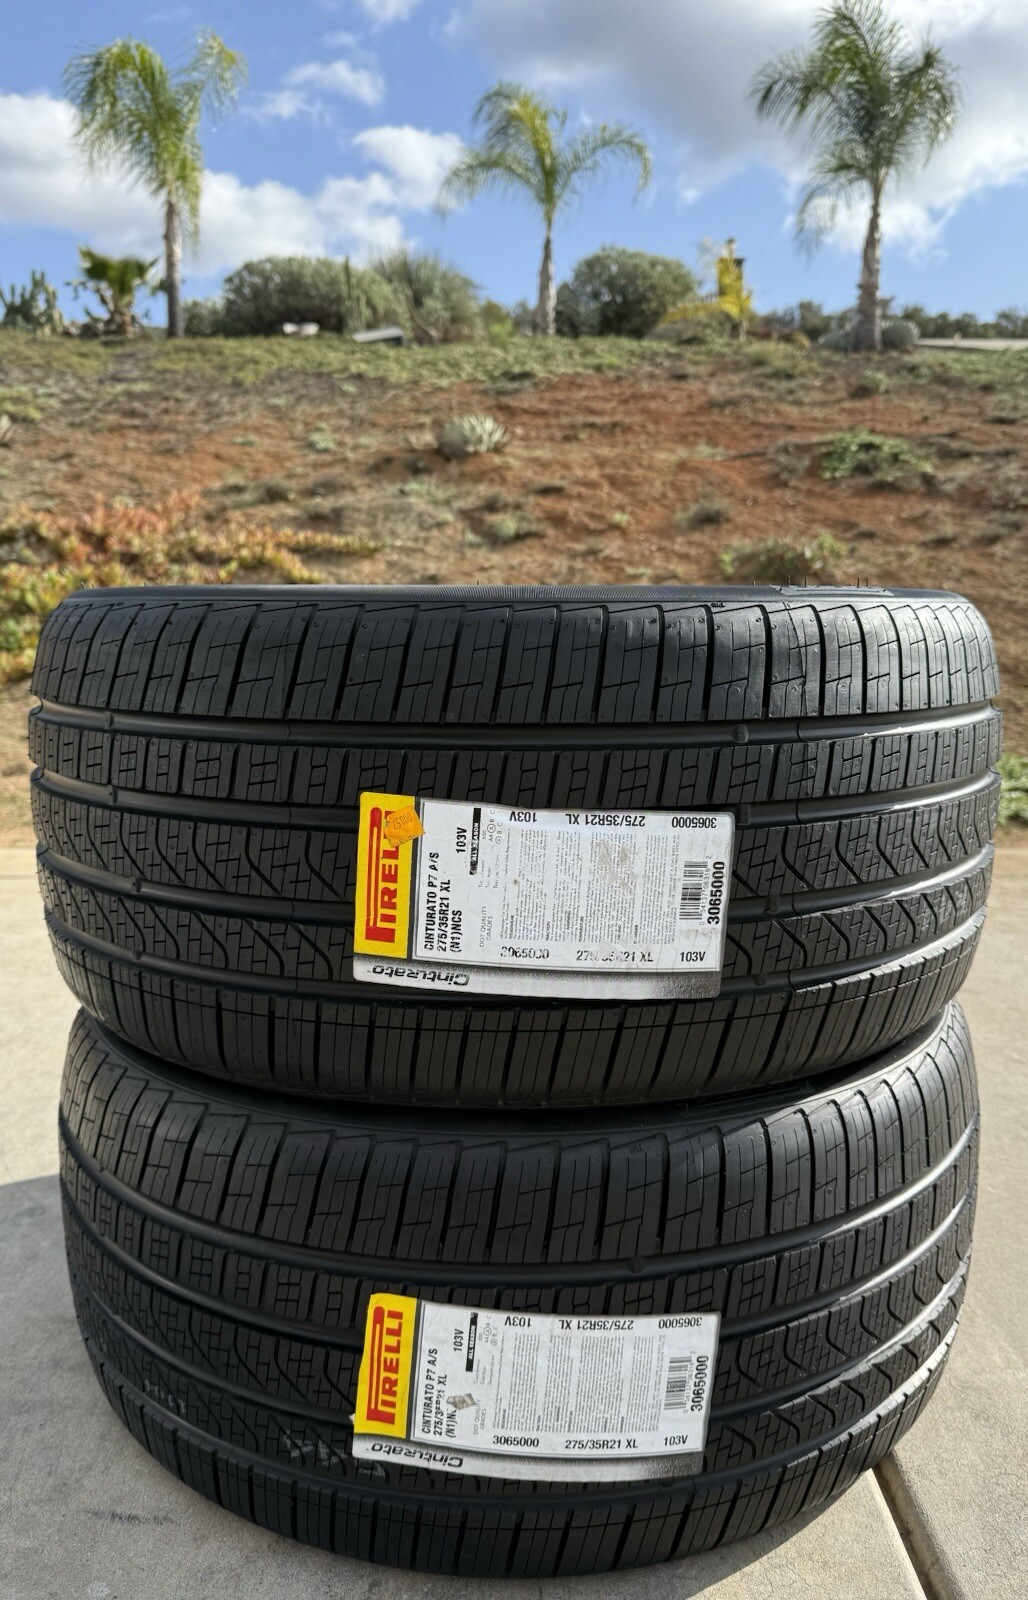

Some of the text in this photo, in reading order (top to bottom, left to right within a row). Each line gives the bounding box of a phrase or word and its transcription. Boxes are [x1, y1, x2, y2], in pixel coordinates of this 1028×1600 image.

[509, 811, 537, 823] 103V
[566, 813, 645, 827] 275/35R21 XL
[671, 816, 718, 828] 3065000
[456, 827, 467, 853] 103V
[365, 807, 399, 943] PIREL
[428, 874, 438, 888] P7
[707, 861, 724, 924] 3065000
[424, 892, 437, 951] CINTURATO
[438, 879, 450, 952] 275/35R21 XL
[450, 910, 462, 952] (N1)NCS
[639, 950, 653, 962] XL
[680, 951, 706, 962] 103V
[504, 1315, 533, 1327] 103V
[559, 1318, 634, 1330] 275/35R21 XL
[658, 1317, 702, 1328] 3065000
[453, 1329, 464, 1352] 103V
[366, 1306, 403, 1425] PIRELLI
[437, 1374, 447, 1385] XL
[691, 1356, 709, 1412] 3065000
[422, 1348, 437, 1434] CINTURATO P7 A/S
[492, 1435, 539, 1447] 3065000
[565, 1438, 638, 1450] 275/35R21 XL
[663, 1434, 688, 1446] 103V
